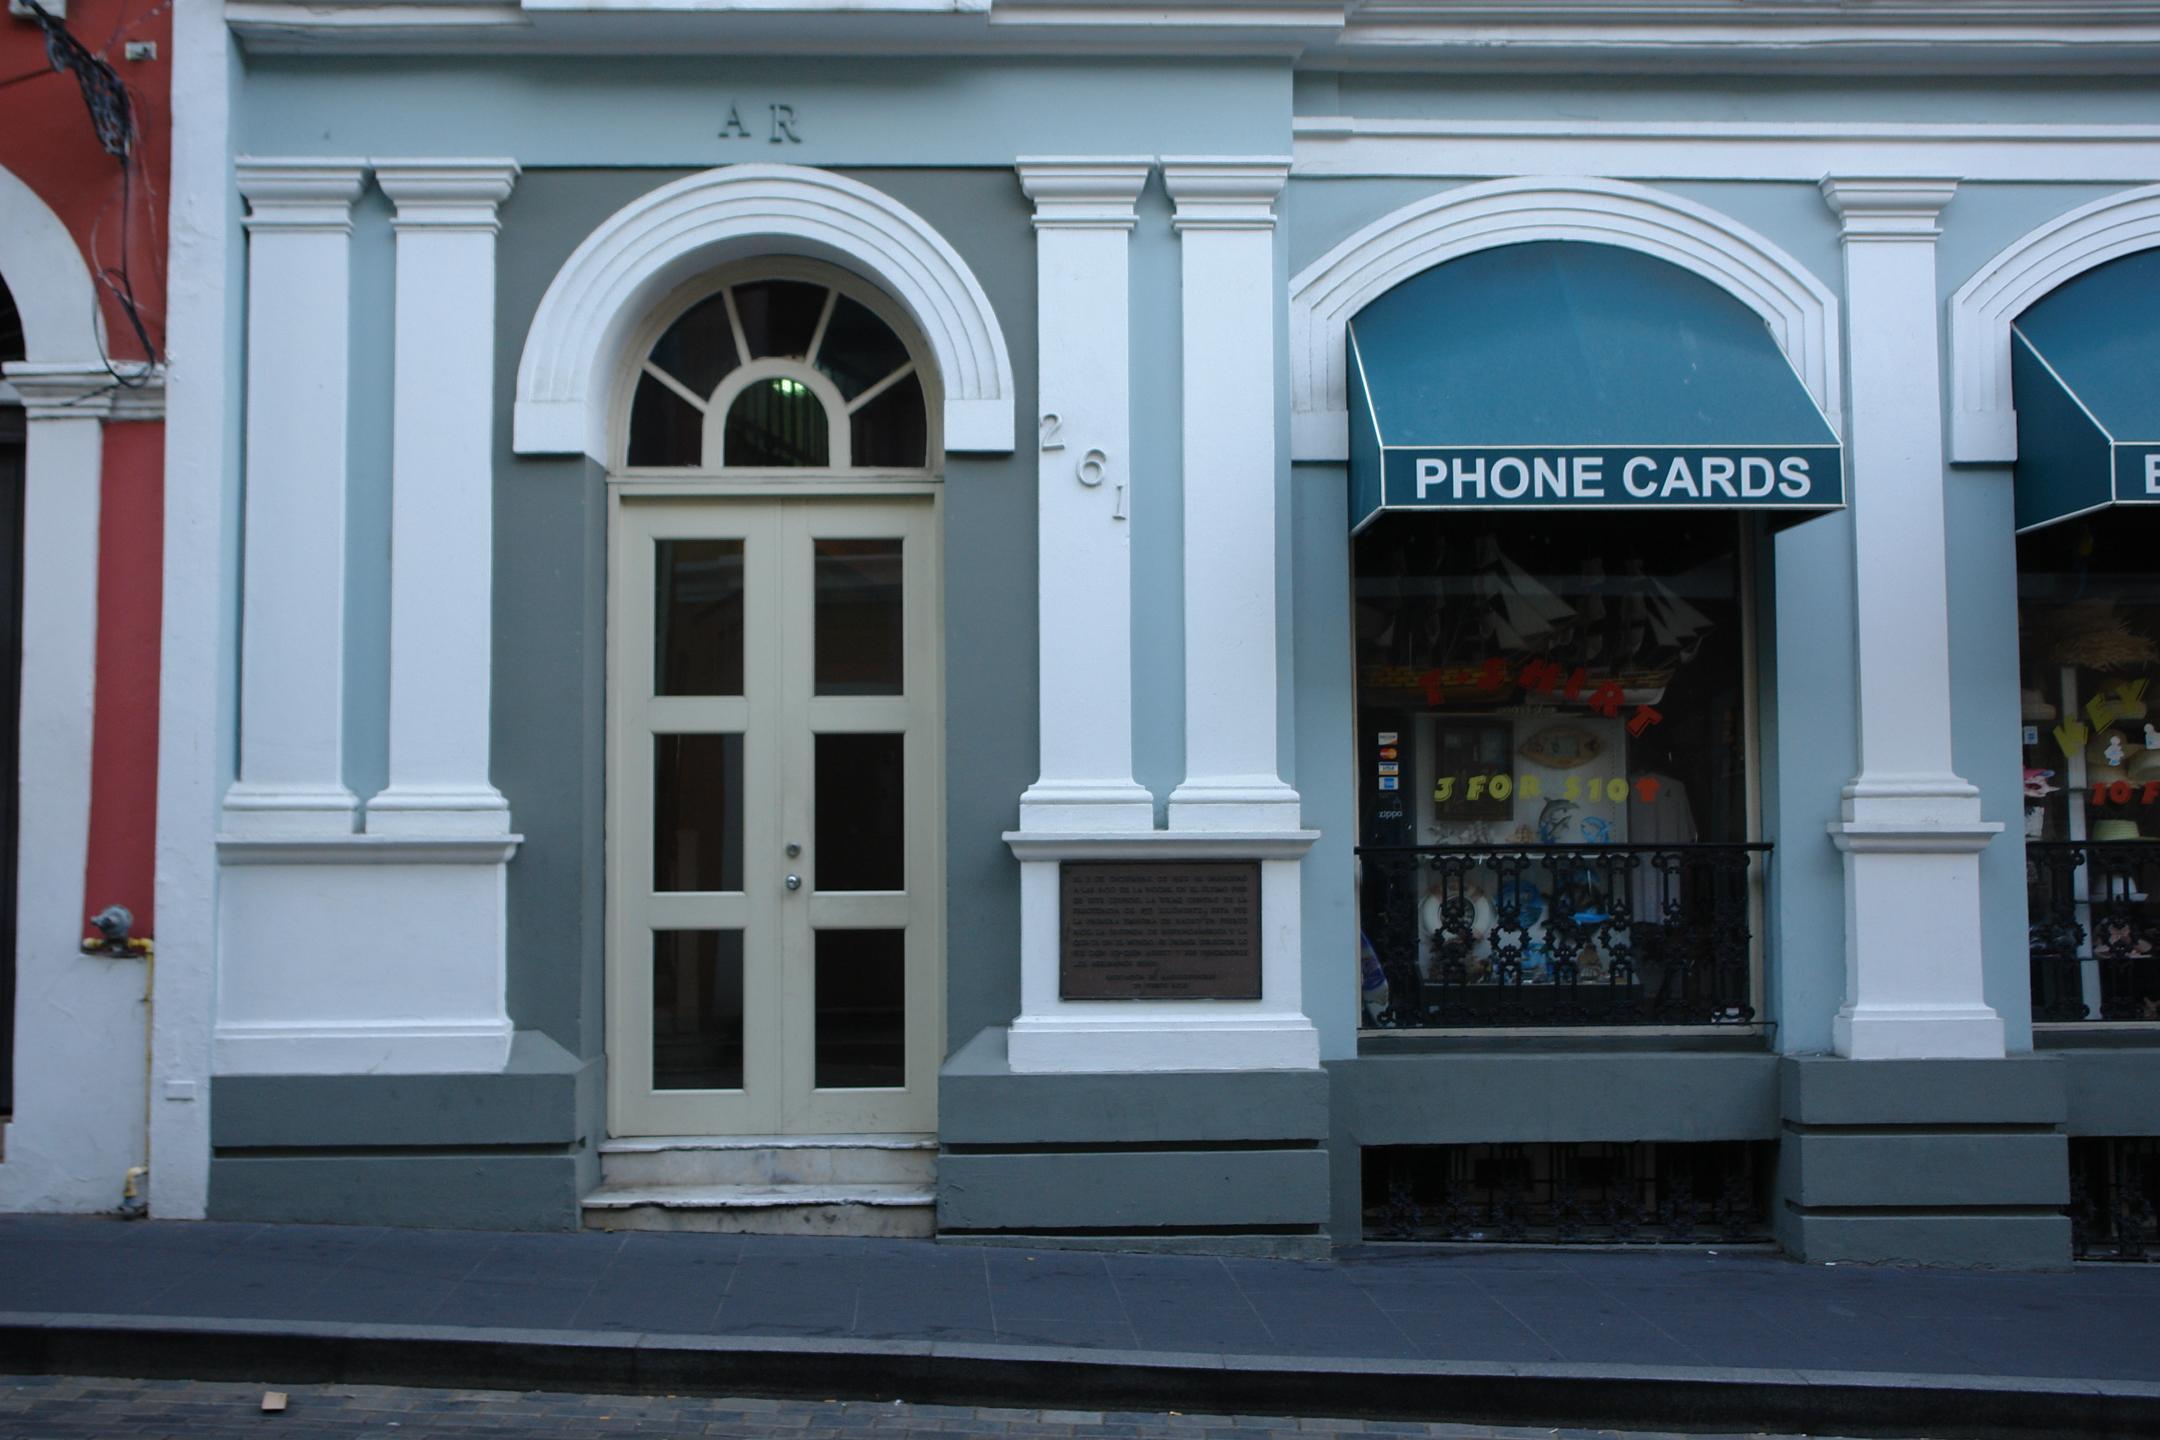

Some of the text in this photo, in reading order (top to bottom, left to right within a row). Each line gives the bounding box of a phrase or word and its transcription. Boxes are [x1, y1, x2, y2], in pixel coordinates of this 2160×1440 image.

[1416, 456, 1812, 499] PHONE CARDS
[1418, 656, 1664, 737] T-SHIRT
[1433, 775, 1456, 802] 3
[1466, 773, 1542, 802] FOR
[2091, 779, 2131, 806] 10
